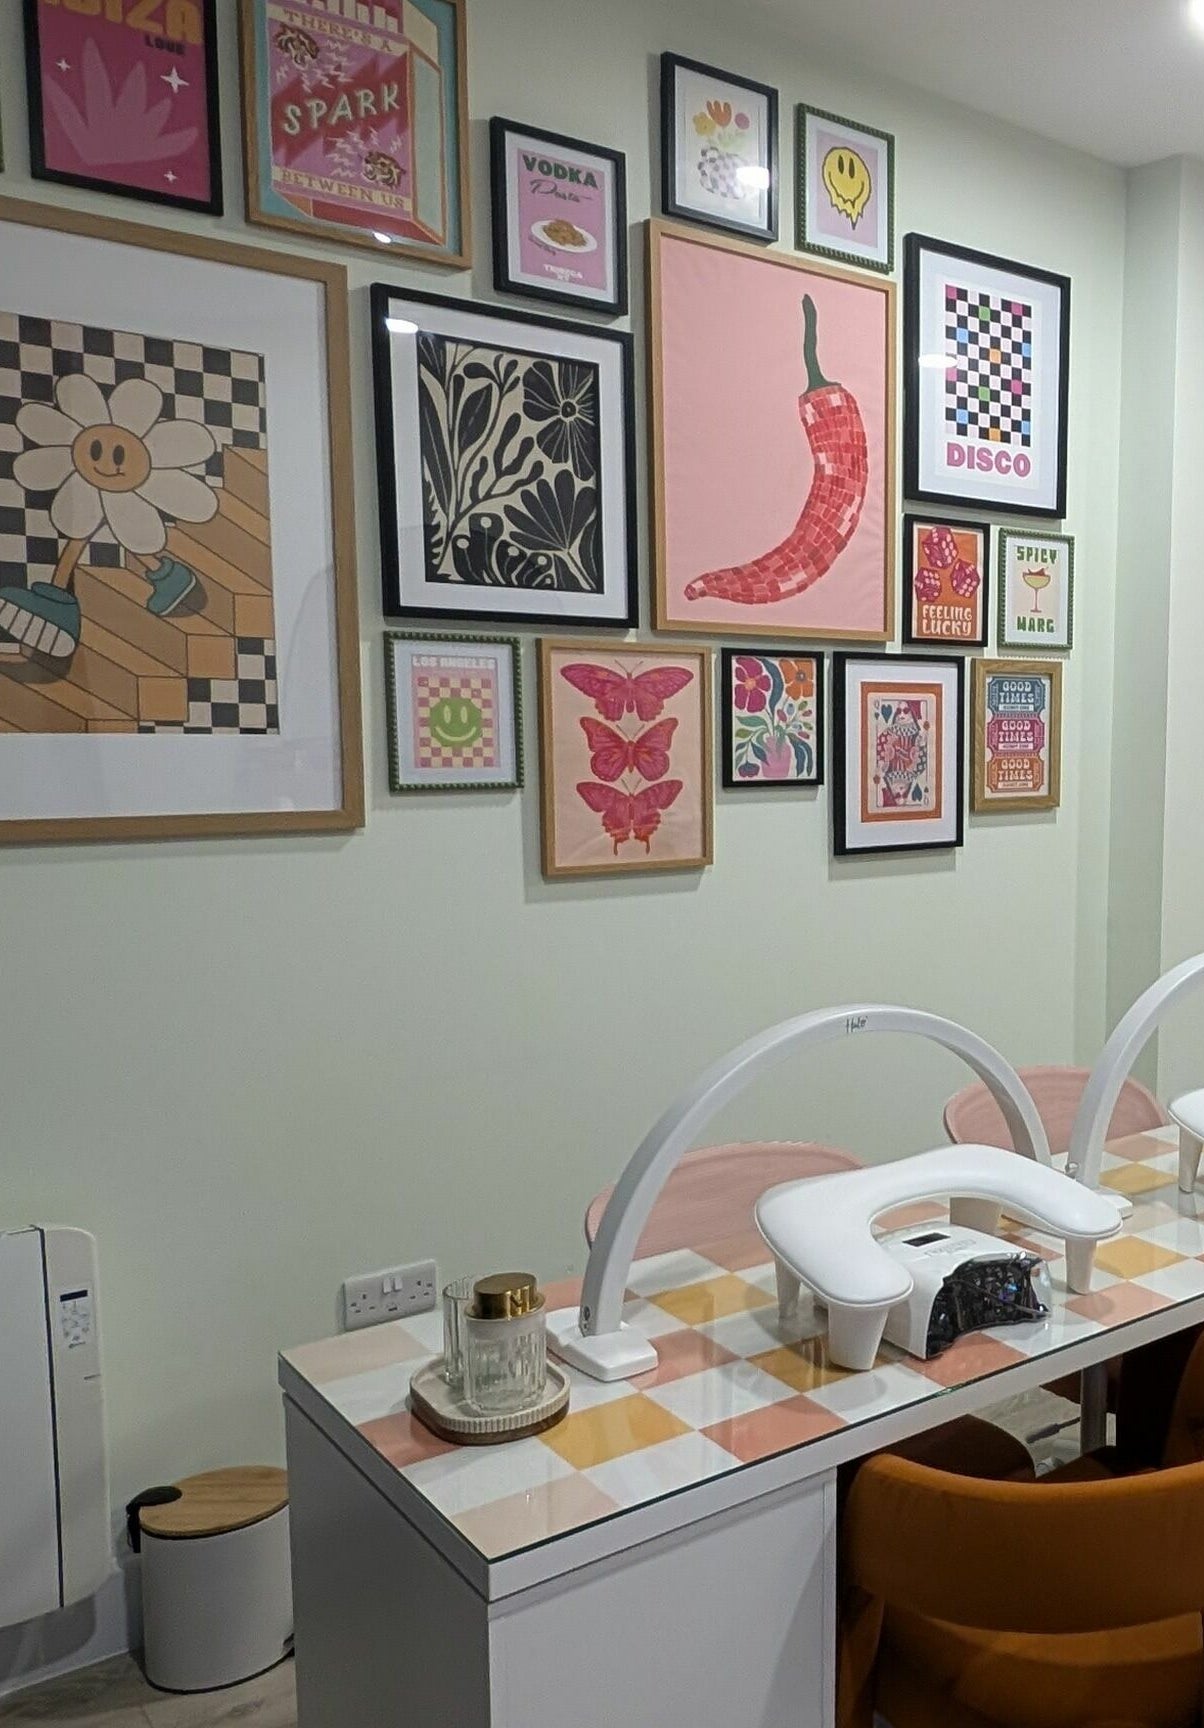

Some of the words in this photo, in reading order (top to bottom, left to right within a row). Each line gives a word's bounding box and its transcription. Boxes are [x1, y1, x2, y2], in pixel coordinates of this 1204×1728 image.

[284, 84, 400, 135] SPARK
[522, 154, 598, 190] VODKA
[282, 170, 375, 202] BETWEEN
[381, 195, 406, 208] US
[946, 442, 1032, 478] DISCO
[1016, 545, 1058, 564] SPICY
[922, 604, 973, 621] FEELING
[922, 619, 972, 636] LUCKY
[1016, 616, 1055, 634] MARG
[412, 656, 438, 667] LOS
[1002, 681, 1032, 692] GOOD
[999, 692, 1035, 703] TIMES
[1001, 720, 1031, 731] GOOD
[998, 731, 1034, 742] TIMES
[1001, 759, 1031, 769] GOOD
